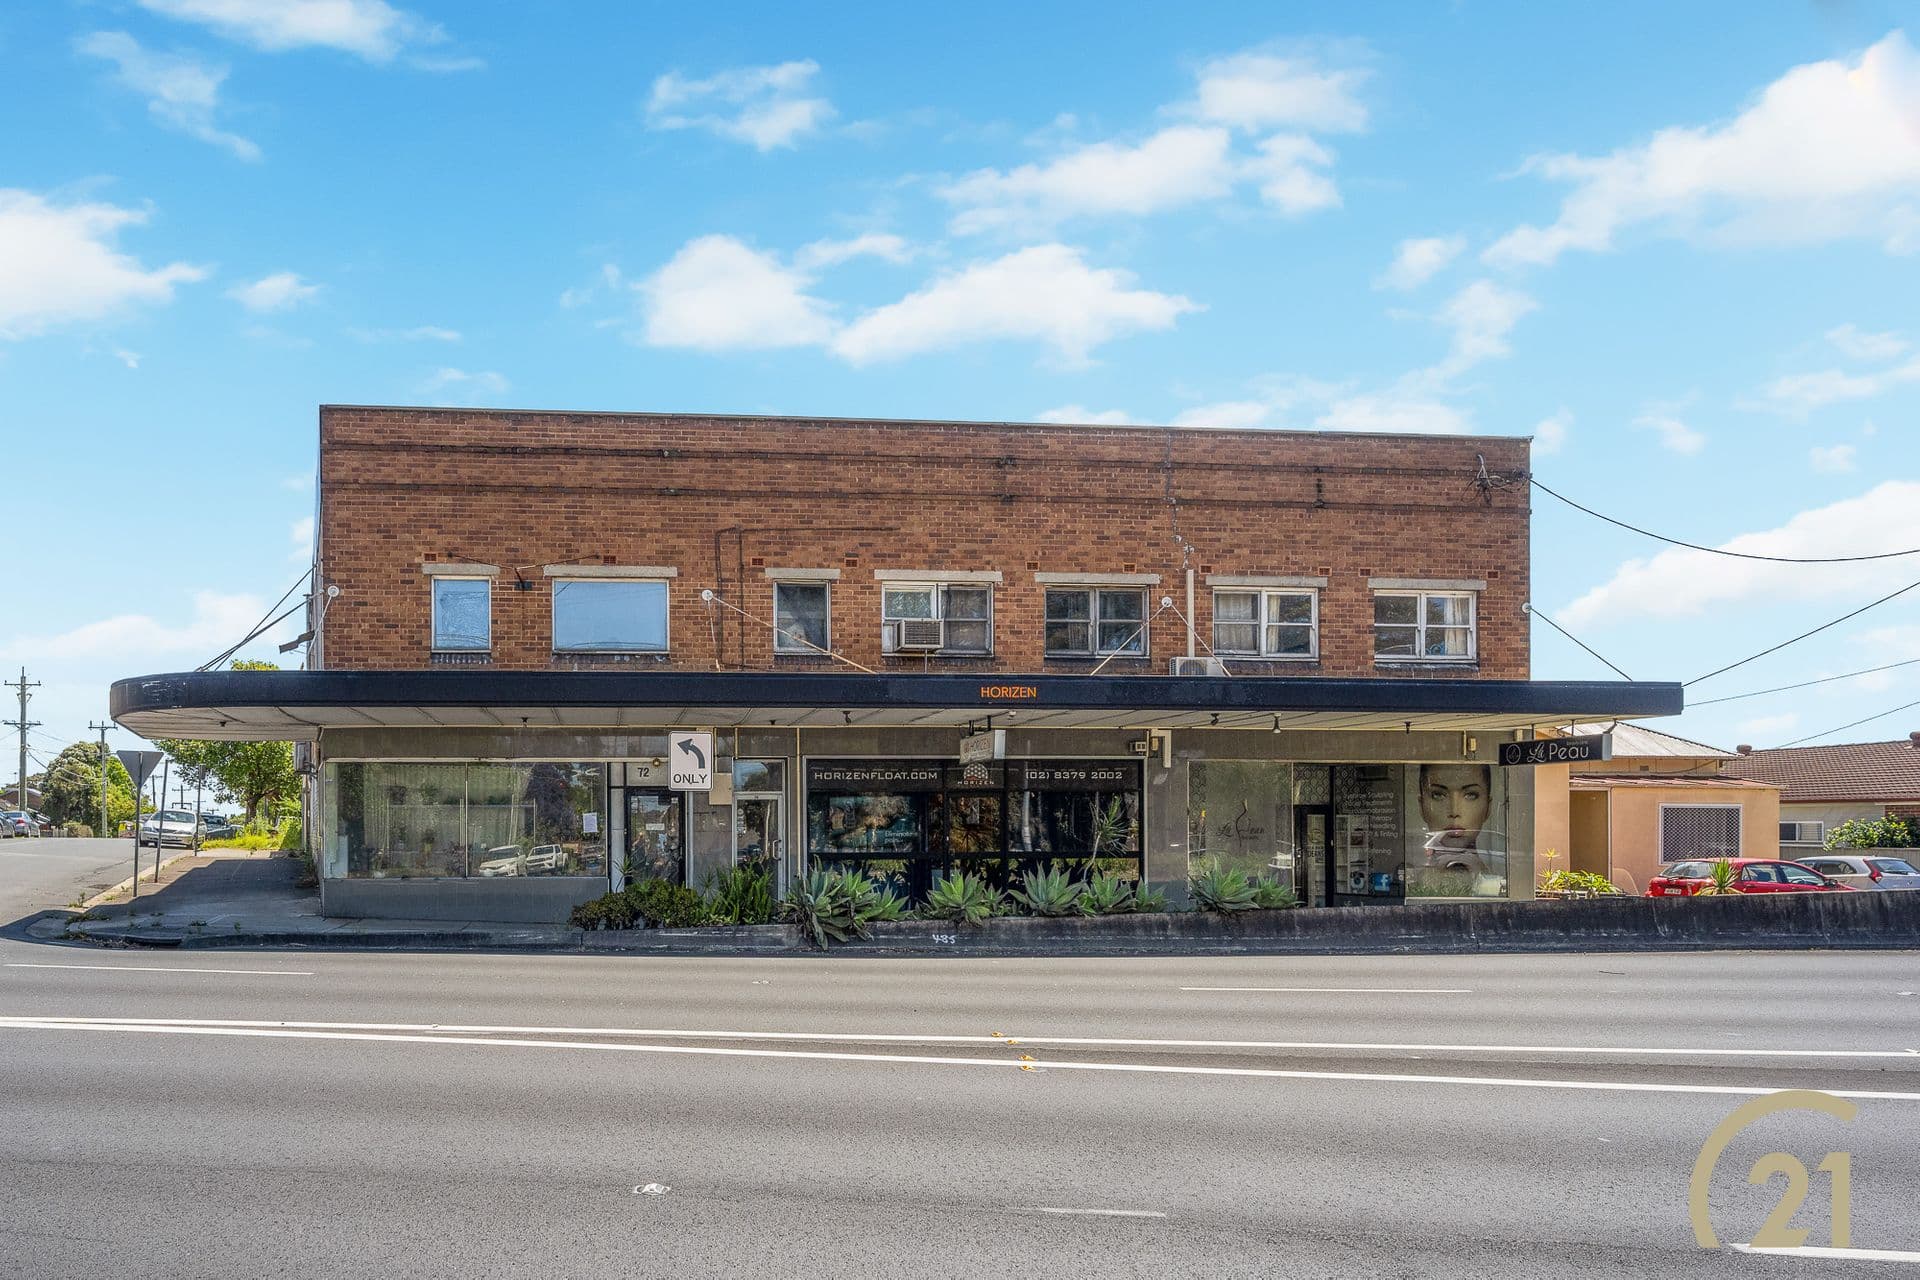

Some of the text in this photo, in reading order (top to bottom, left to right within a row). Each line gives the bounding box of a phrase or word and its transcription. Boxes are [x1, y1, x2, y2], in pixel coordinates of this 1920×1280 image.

[980, 686, 1037, 698] HORIZEN
[1549, 743, 1589, 761] Peau
[637, 767, 650, 777] 72
[814, 771, 938, 780] HORIZENFLOAT.COM
[1025, 771, 1123, 779] (02) 8379 2002
[673, 773, 708, 784] ONLY
[932, 934, 957, 944] 485
